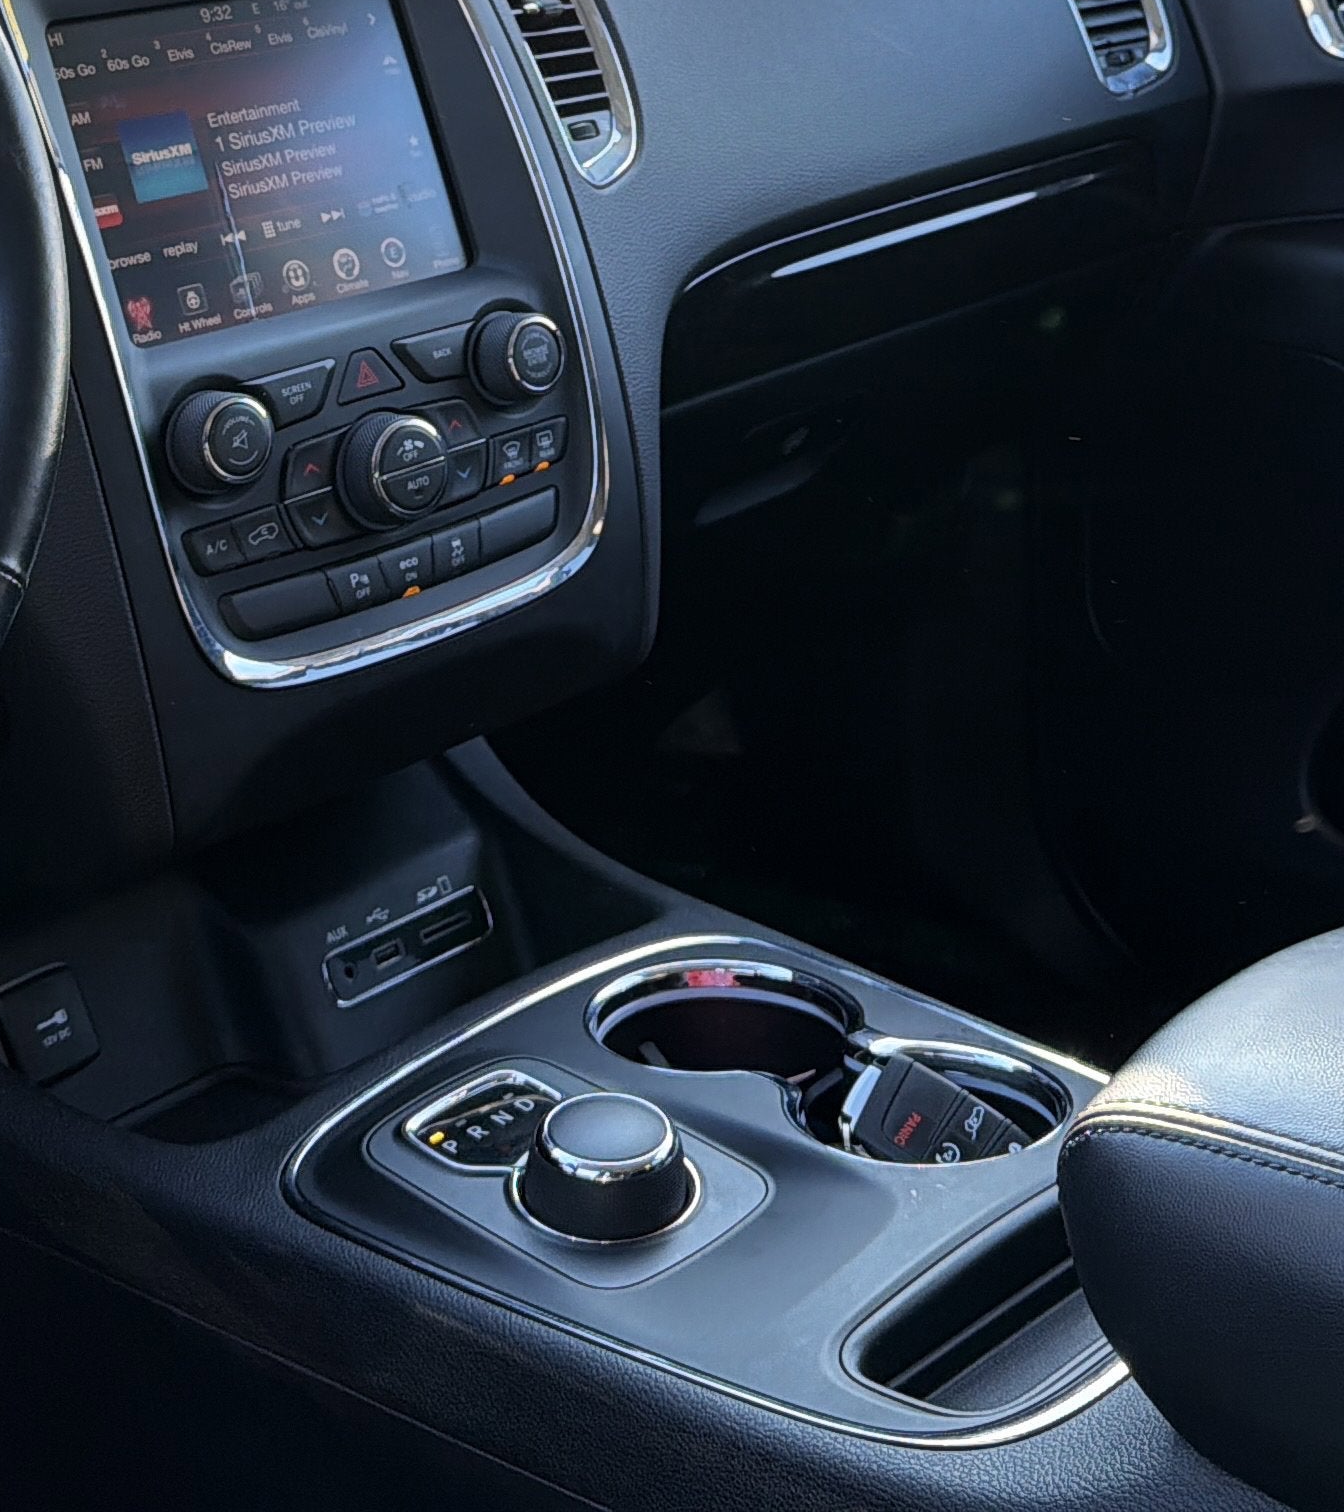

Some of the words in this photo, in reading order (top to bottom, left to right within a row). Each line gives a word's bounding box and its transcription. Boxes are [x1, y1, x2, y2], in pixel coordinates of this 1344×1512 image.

[200, 4, 232, 24] 9:32
[267, 32, 293, 46] Elvis
[101, 49, 108, 59] 2
[106, 58, 129, 72] 60s
[131, 54, 151, 69] Go
[167, 47, 195, 63] Elvis
[77, 63, 97, 78] Go
[71, 112, 91, 127] AM
[207, 100, 301, 128] Entertainment
[215, 135, 225, 152] 1
[228, 122, 296, 150] SiriusXM
[297, 114, 356, 136] Preview
[131, 142, 193, 167] SiriusXM
[221, 152, 282, 177] SiriusXM
[284, 143, 337, 164] Preview
[83, 157, 103, 172] FM
[228, 173, 289, 200] SiriusXM
[291, 164, 343, 186] Preview
[276, 217, 302, 232] tune
[163, 240, 198, 260] replay
[291, 291, 316, 306] Apps
[233, 302, 274, 320] Conrols
[133, 329, 162, 345] Radio
[281, 381, 312, 397] SCREEN
[289, 393, 305, 405] OFF
[402, 451, 418, 462] OFF
[407, 475, 430, 491] AUTO
[207, 541, 228, 556] A/C
[399, 557, 419, 570] eco
[356, 587, 371, 600] OFF
[326, 925, 349, 944] AUX
[441, 1139, 458, 1154] P
[466, 1125, 490, 1140] R
[490, 1109, 514, 1126] N
[513, 1098, 535, 1112] D
[893, 1111, 923, 1149] PANIC
